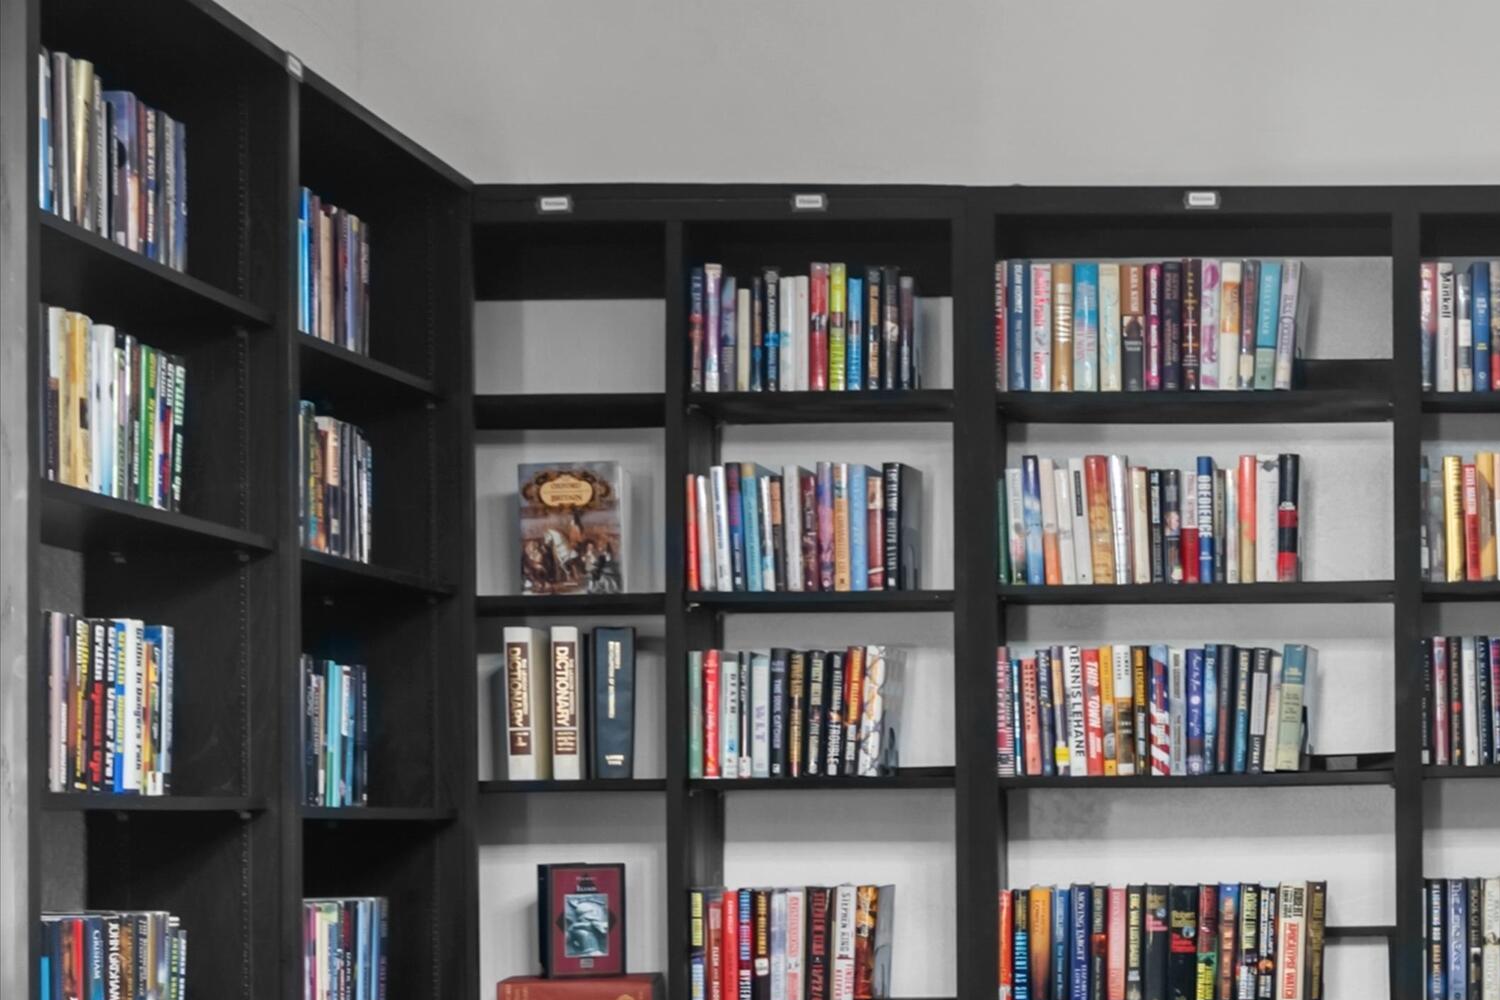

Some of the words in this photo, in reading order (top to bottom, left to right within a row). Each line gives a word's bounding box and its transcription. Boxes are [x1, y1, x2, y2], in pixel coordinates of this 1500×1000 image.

[1440, 272, 1452, 318] Mankell
[1199, 475, 1212, 537] OBEDIENCE
[94, 625, 105, 681] Griffin
[1239, 652, 1248, 672] LADY
[510, 647, 524, 727] DICTIONARY
[555, 646, 570, 727] DICTIONARY
[1070, 645, 1082, 698] DENNIS
[1086, 661, 1099, 687] THIS
[1087, 695, 1101, 728] TOWN
[1239, 691, 1248, 710] LAKE
[1072, 702, 1085, 757] LEHANE
[1076, 891, 1086, 928] MOVING
[1432, 890, 1441, 926] LIGHTNING
[1451, 883, 1463, 905] THE
[840, 893, 850, 930] STEPHEN
[1451, 907, 1463, 937] ZERO
[108, 922, 121, 951] JOHN
[839, 932, 850, 953] KING
[1015, 932, 1027, 970] INNOCENT
[1076, 930, 1086, 960] TARGET
[1432, 928, 1441, 941] ROD
[93, 930, 104, 979] GRISHAM
[1432, 944, 1441, 963] BRAD
[1451, 940, 1463, 971] GAME
[1432, 964, 1441, 993] MELTZER
